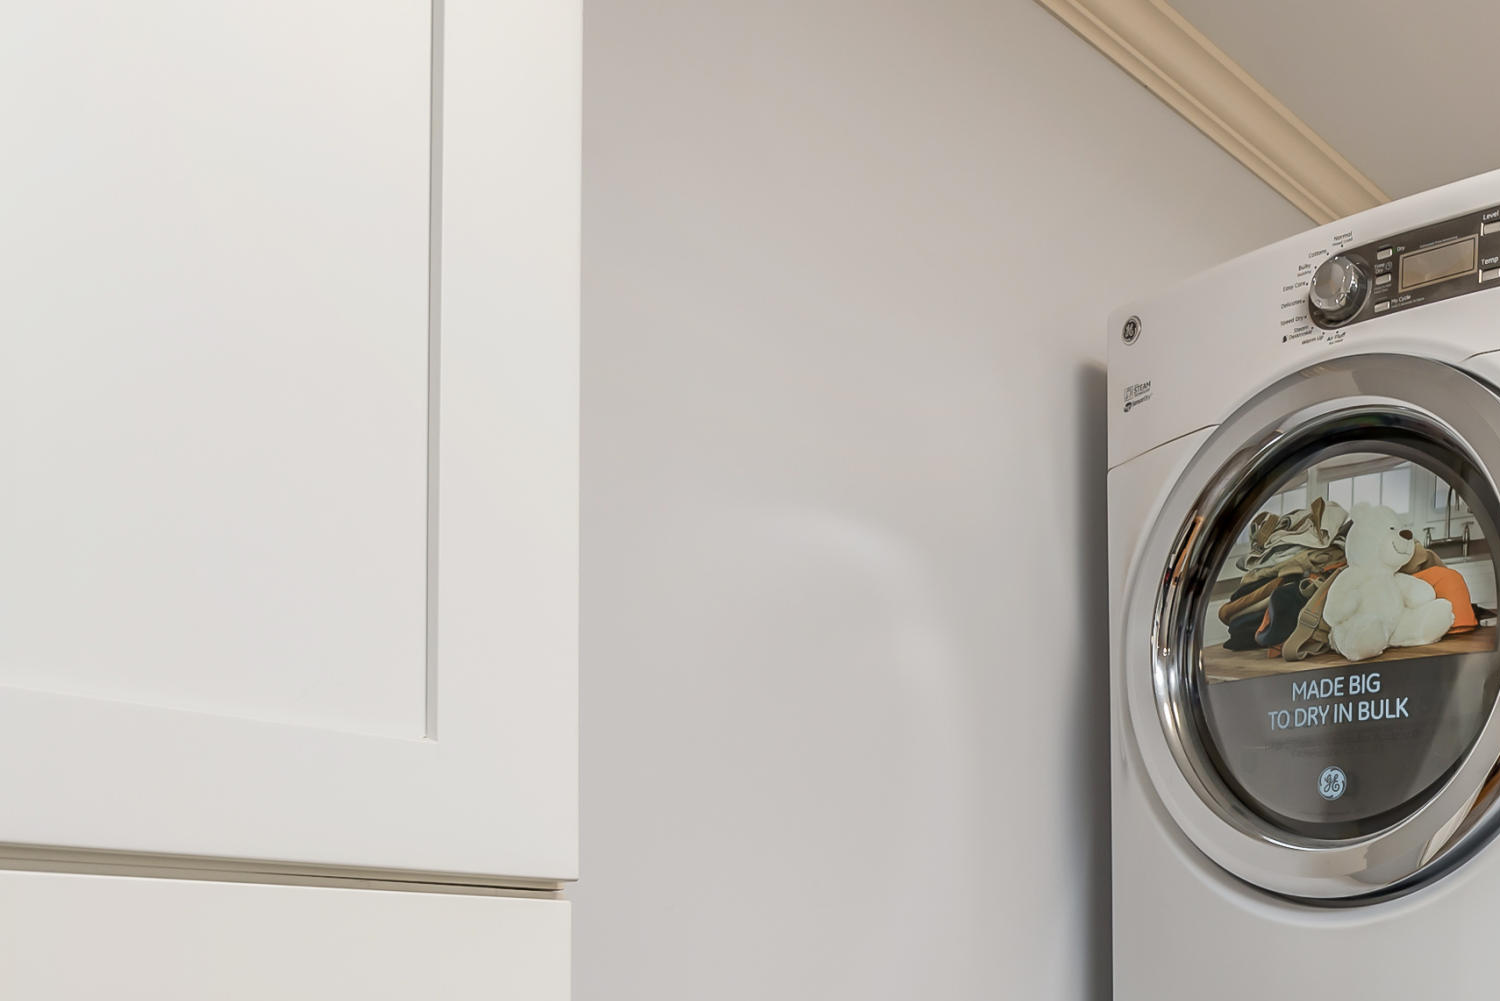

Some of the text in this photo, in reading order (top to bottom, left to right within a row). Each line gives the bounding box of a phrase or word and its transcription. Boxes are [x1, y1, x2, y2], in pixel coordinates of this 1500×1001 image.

[1482, 210, 1500, 220] Level
[1333, 232, 1352, 241] Normal
[1481, 256, 1499, 266] Temp
[1292, 673, 1381, 701] MADE BIG
[1267, 697, 1409, 730] TO DRY IN BULK
